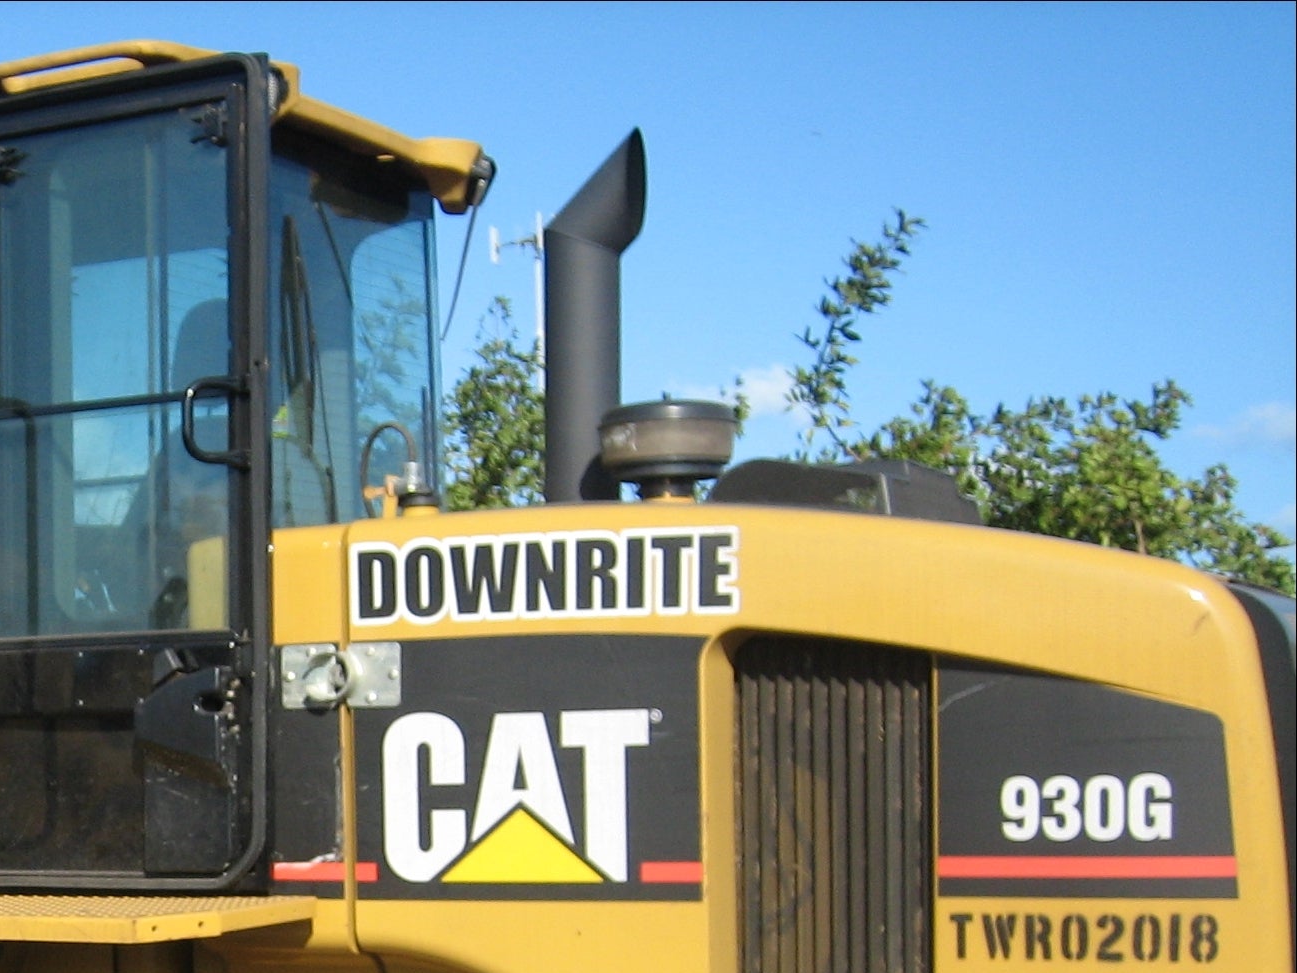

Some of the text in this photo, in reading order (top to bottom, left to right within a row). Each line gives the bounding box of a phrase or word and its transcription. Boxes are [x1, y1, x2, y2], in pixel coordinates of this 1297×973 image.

[354, 529, 737, 622] DOWNRITE
[381, 708, 650, 883] CAT
[1001, 772, 1173, 842] 930G
[949, 913, 1219, 963] TWR02018
